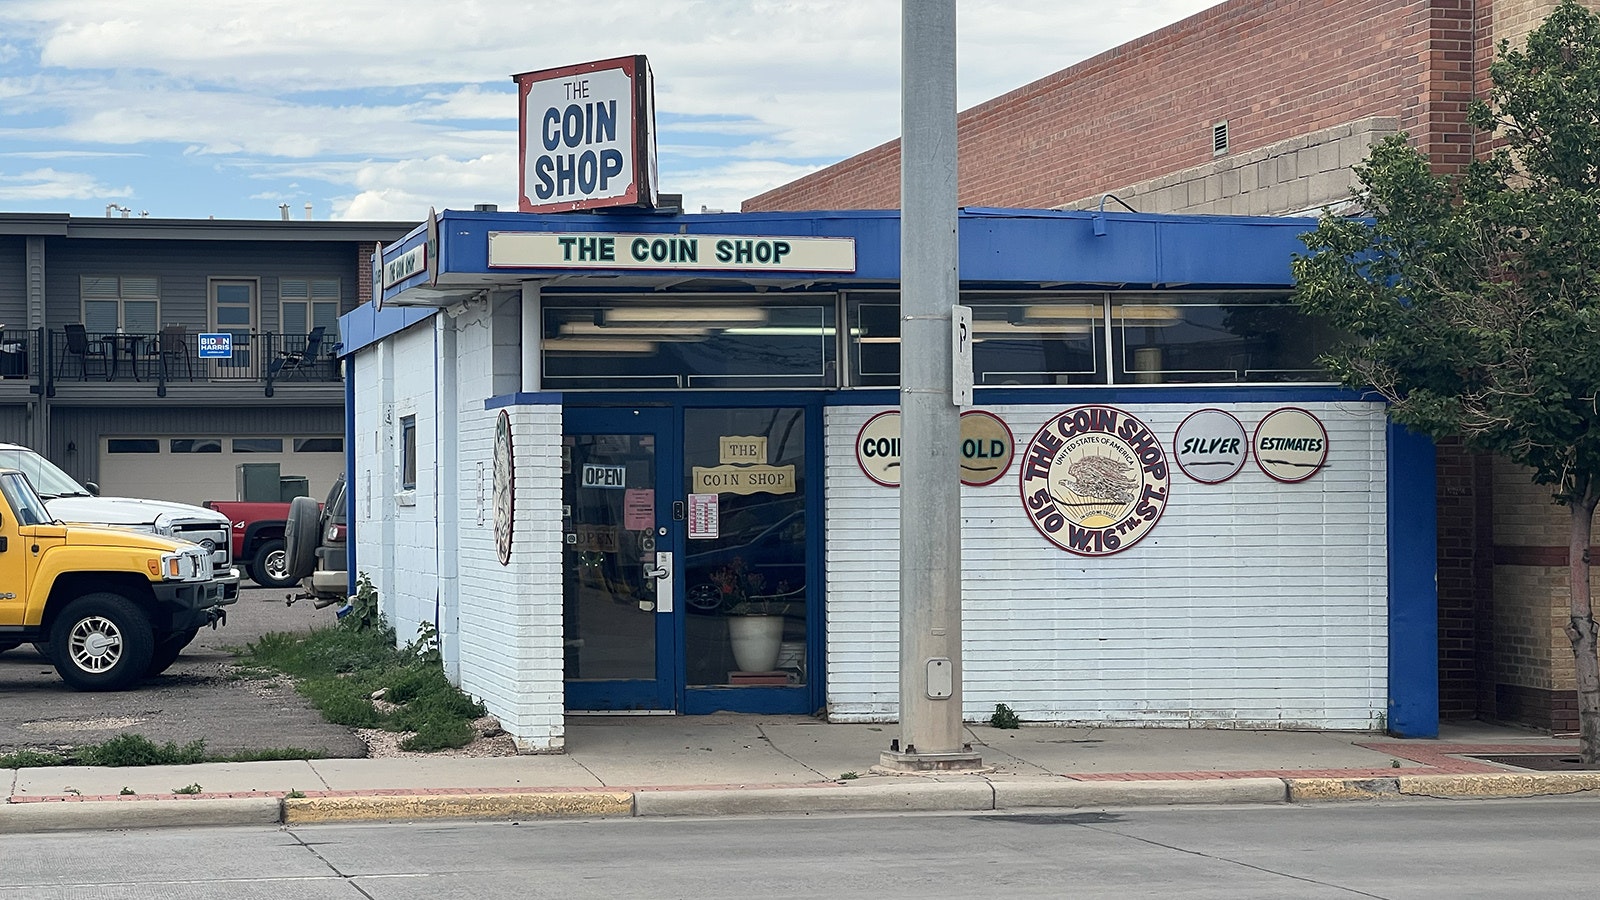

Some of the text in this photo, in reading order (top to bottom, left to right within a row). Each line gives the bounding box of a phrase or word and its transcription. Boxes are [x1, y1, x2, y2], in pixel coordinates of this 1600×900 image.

[563, 80, 590, 101] THE
[542, 100, 617, 152] COIN
[534, 148, 623, 200] SHOP
[558, 236, 792, 264] THE COIN SHOP
[730, 444, 757, 456] THE
[961, 439, 1005, 458] OLD
[1024, 429, 1063, 481] THE
[1058, 408, 1118, 435] COIN
[1056, 436, 1135, 466] UNITED STATES OF AMERICA
[1181, 436, 1241, 455] SILVER
[1260, 437, 1323, 452] ESTIMATES
[585, 467, 623, 486] OPEN
[703, 473, 785, 486] COIN SHOP
[1028, 488, 1064, 534] 510
[578, 532, 613, 546] OPEN
